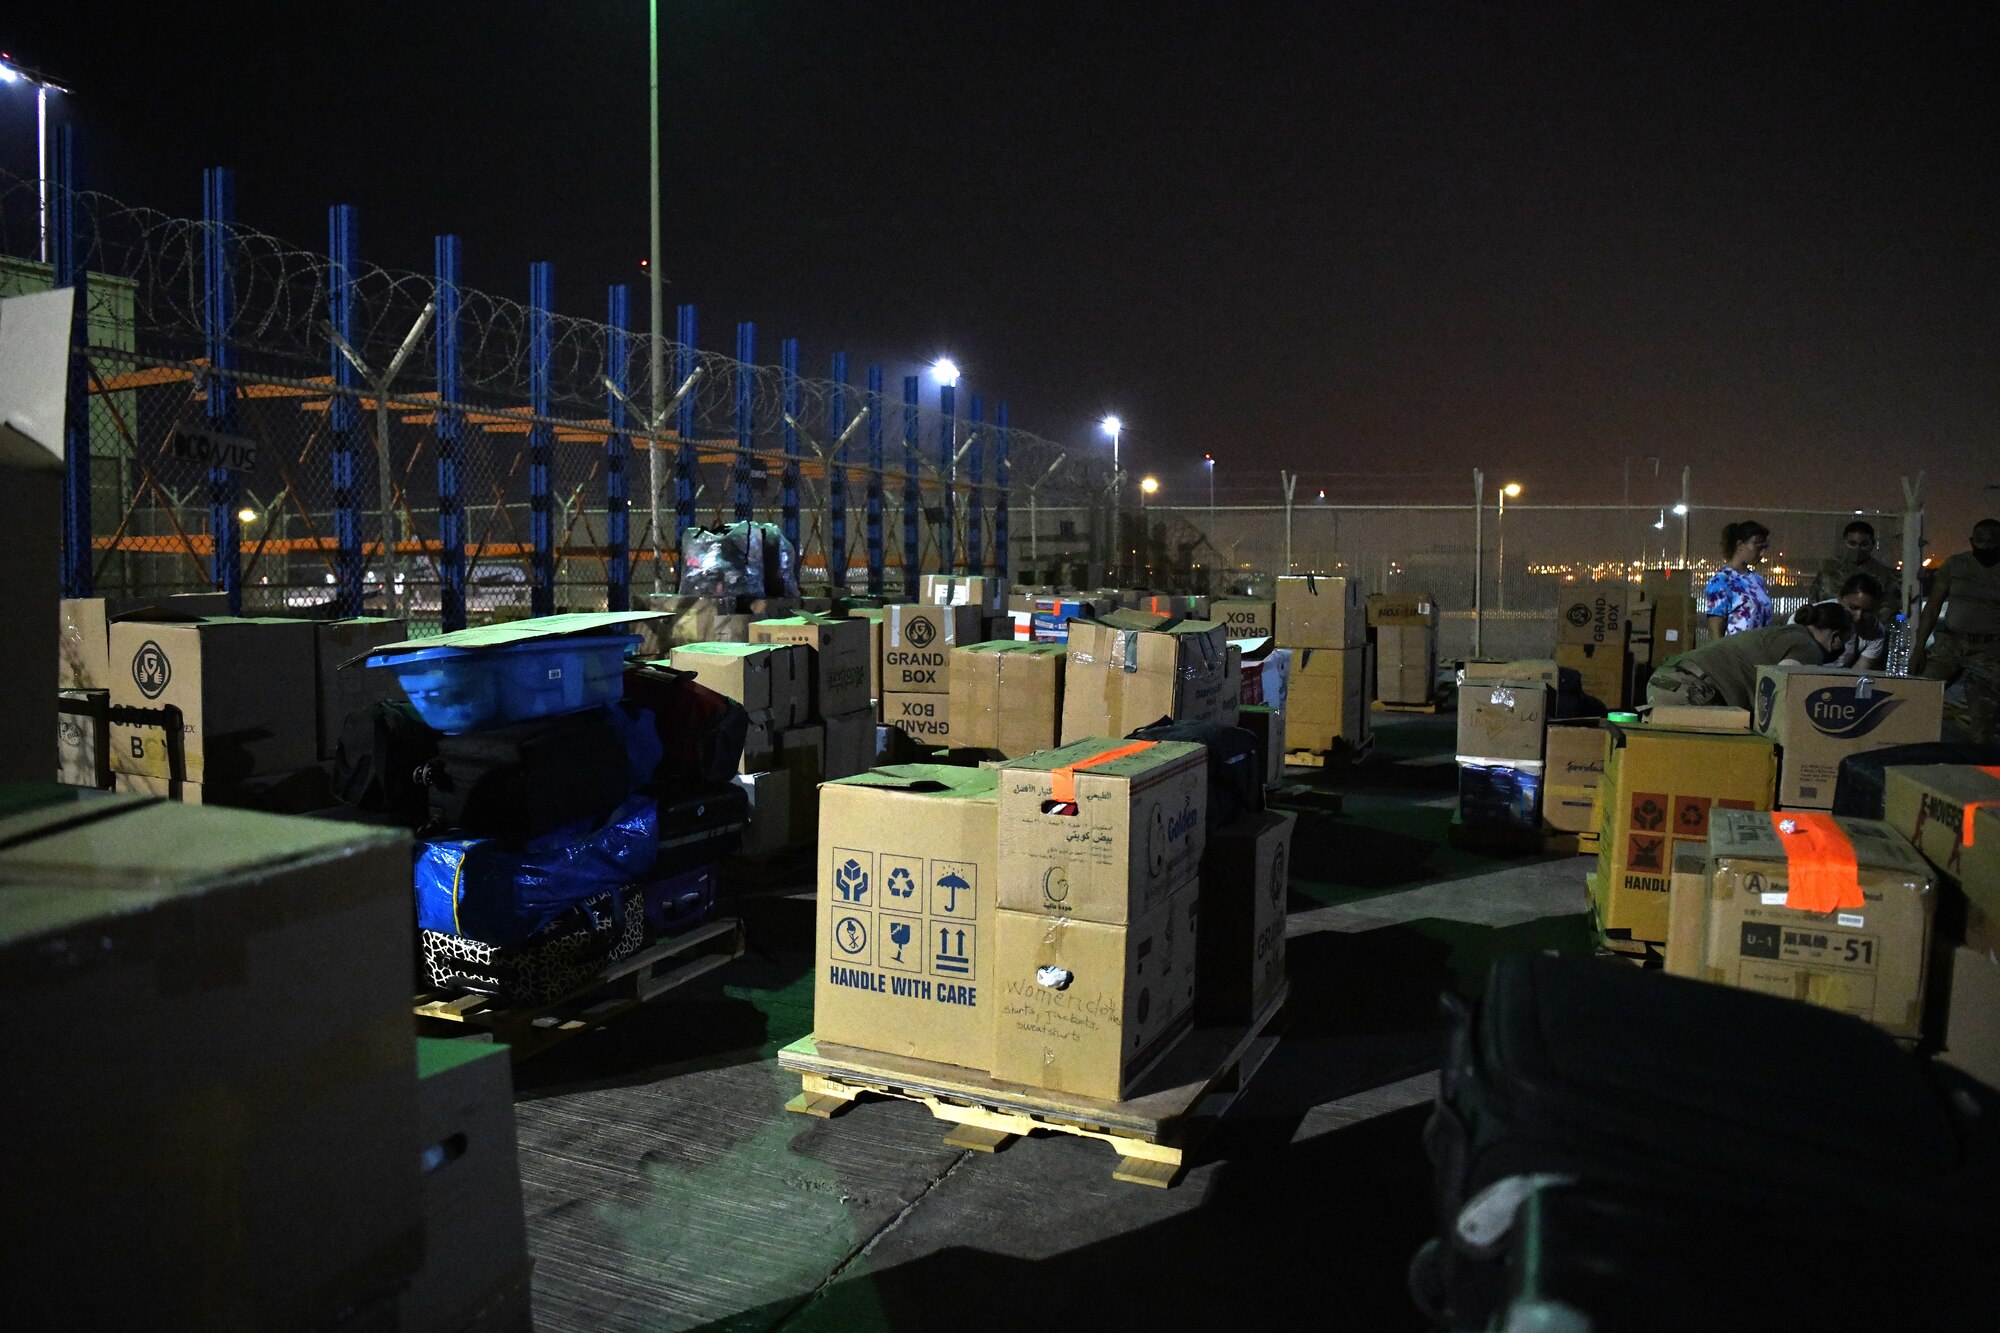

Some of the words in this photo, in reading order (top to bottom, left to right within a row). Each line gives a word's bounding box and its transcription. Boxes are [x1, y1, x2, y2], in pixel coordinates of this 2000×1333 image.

[1227, 612, 1255, 624] BOX
[1594, 598, 1606, 642] GRAND
[1608, 604, 1619, 630] BOX
[887, 652, 944, 666] GRAND
[902, 669, 936, 683] BOX
[902, 702, 935, 717] BOX
[830, 966, 886, 993] HANDLE
[891, 976, 931, 1000] WITH
[937, 982, 976, 1007] CARE
